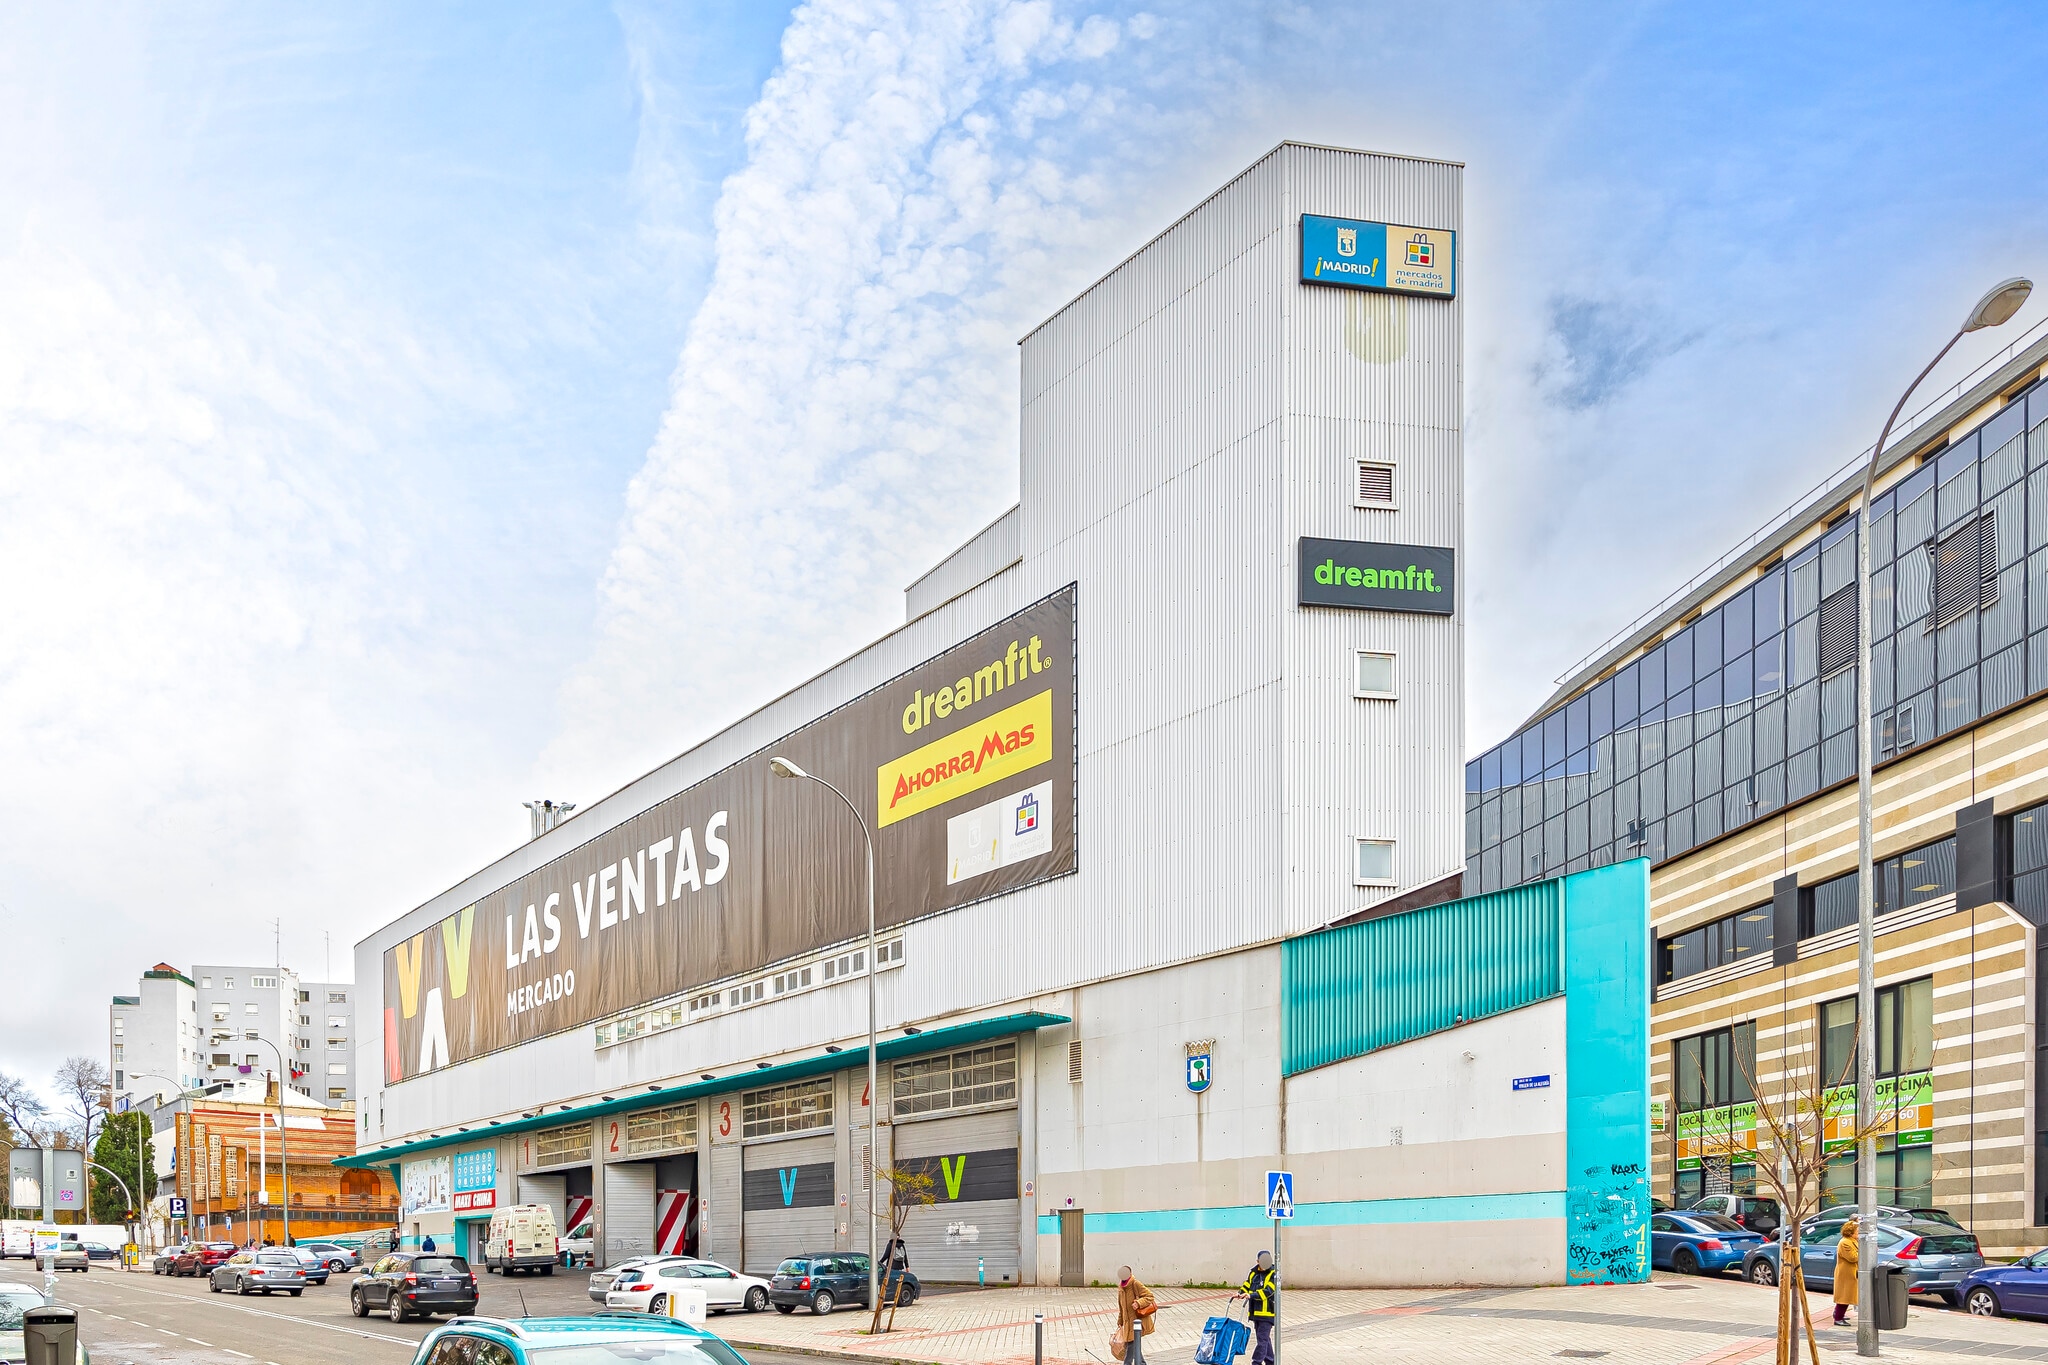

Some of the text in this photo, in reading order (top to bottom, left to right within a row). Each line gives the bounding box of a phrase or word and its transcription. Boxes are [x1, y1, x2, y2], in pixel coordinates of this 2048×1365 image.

[1314, 257, 1379, 278] ¡MADRID!
[1396, 270, 1442, 280] mercados
[1395, 277, 1443, 289] de madrid
[506, 810, 730, 970] LAS VENTAS
[507, 969, 575, 1017] MERCADO
[1826, 1088, 1858, 1102] LOCA
[719, 1101, 731, 1137] 3
[1841, 1118, 1853, 1127] 91
[1900, 1109, 1914, 1120] 60
[610, 1121, 619, 1153] 2
[523, 1138, 529, 1165] 1
[173, 1200, 184, 1210] P
[455, 1191, 492, 1208] MAXI CHINA
